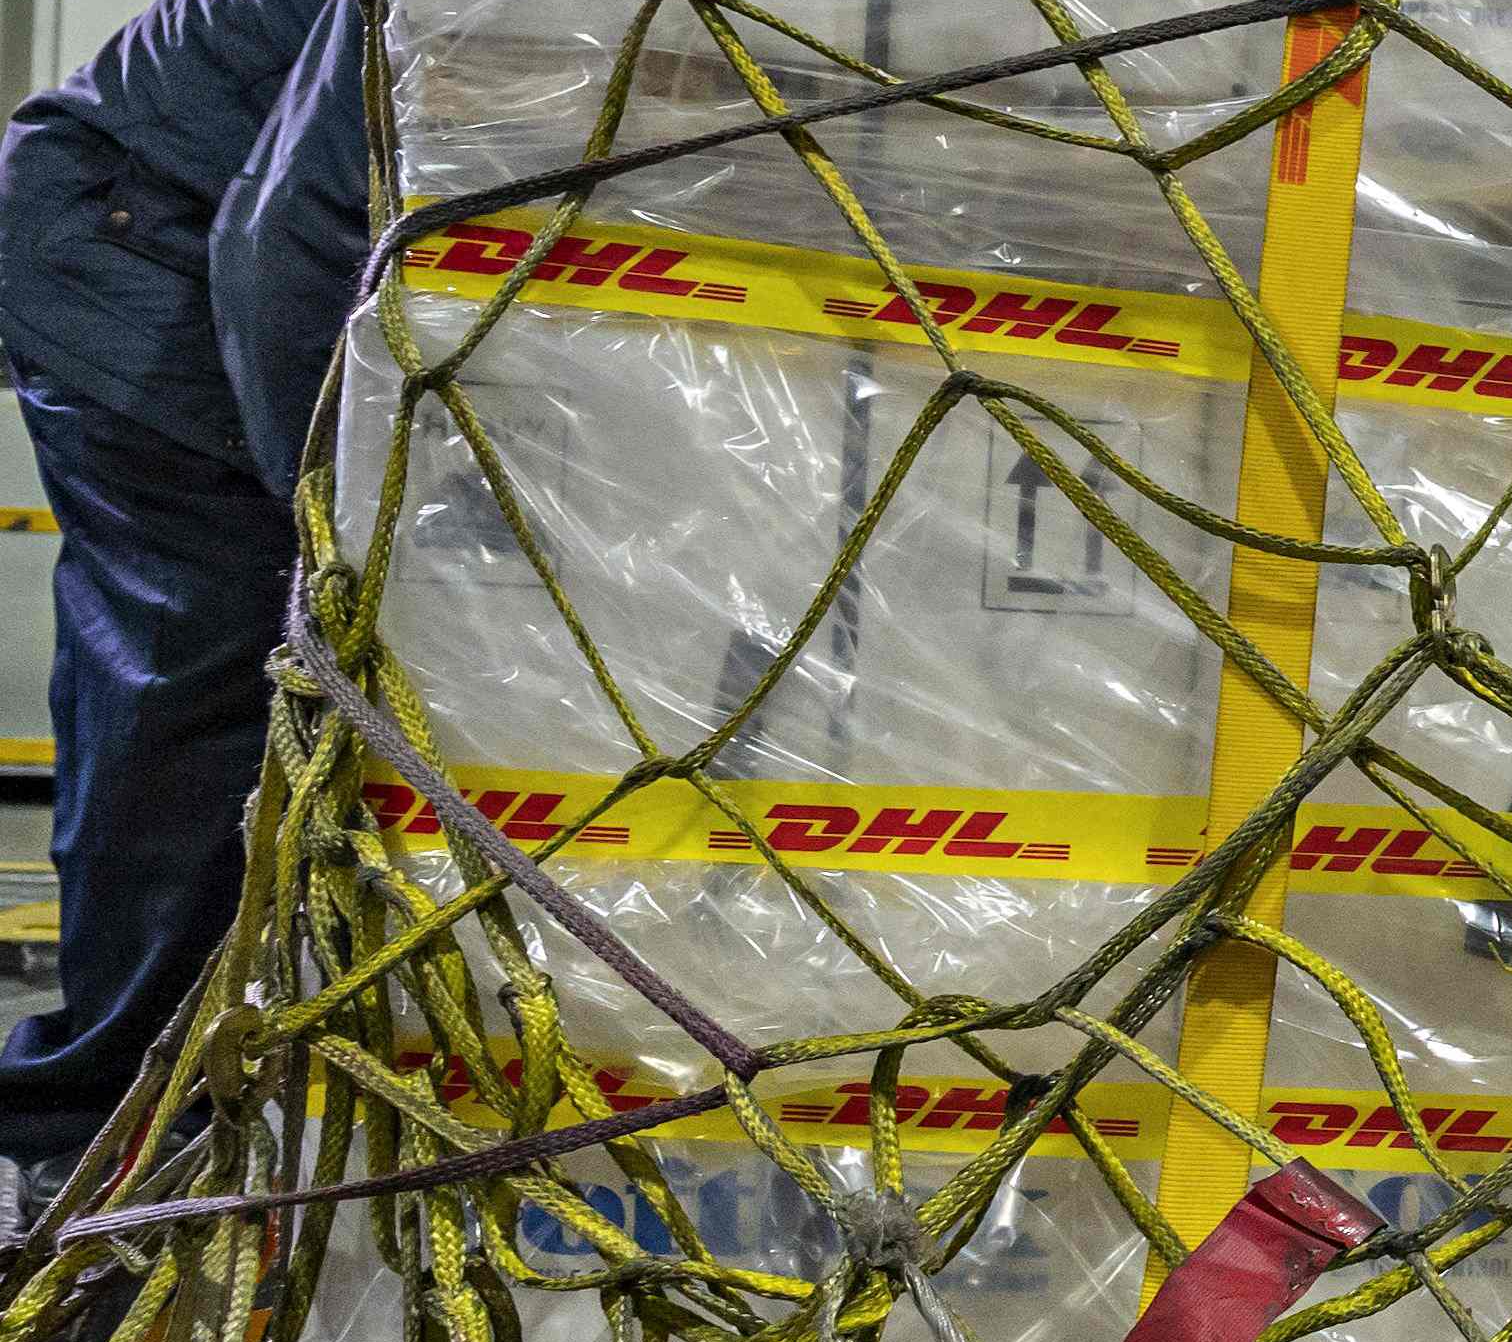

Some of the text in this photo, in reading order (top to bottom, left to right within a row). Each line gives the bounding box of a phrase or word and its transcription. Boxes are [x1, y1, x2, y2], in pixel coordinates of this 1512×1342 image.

[437, 228, 696, 295] DHL
[875, 286, 1130, 349] DHL
[768, 805, 1018, 857] DHL
[1272, 1103, 1507, 1150] DHL
